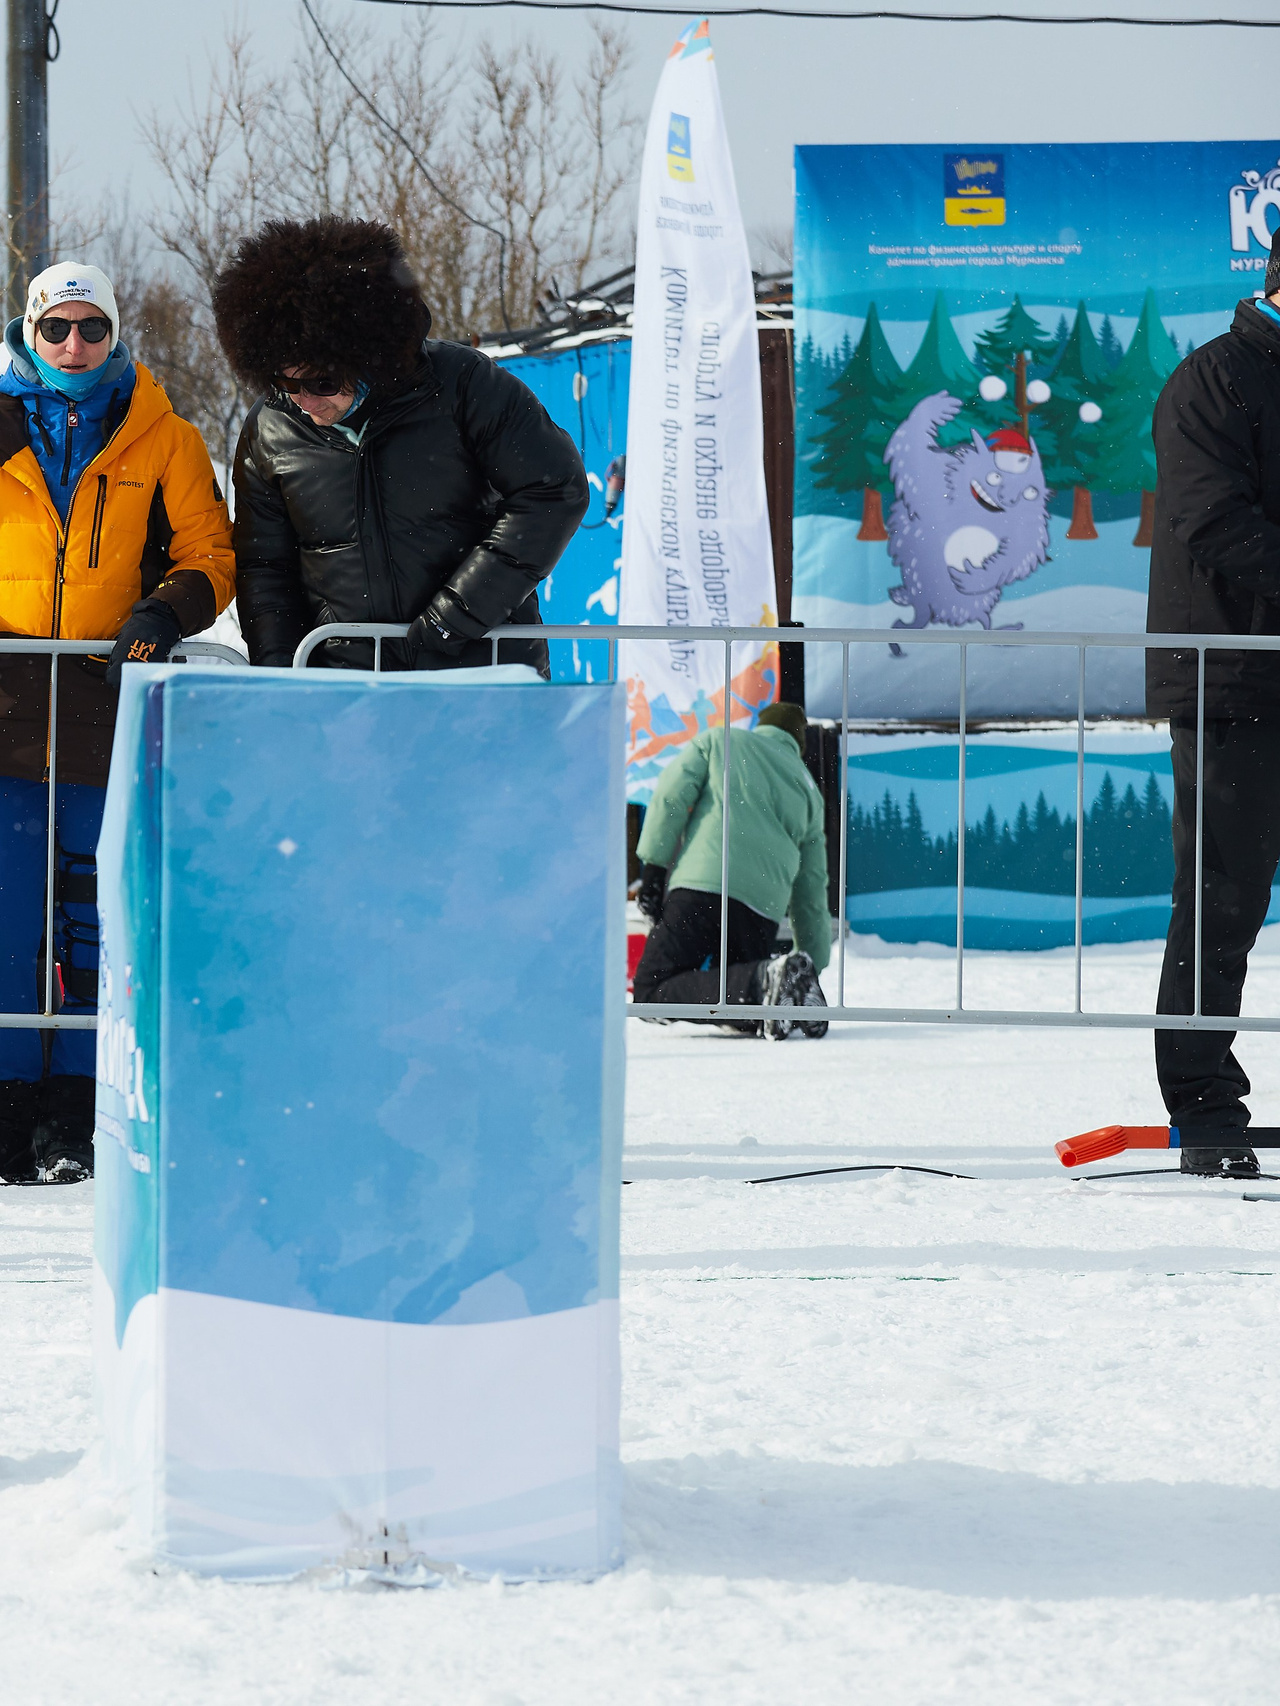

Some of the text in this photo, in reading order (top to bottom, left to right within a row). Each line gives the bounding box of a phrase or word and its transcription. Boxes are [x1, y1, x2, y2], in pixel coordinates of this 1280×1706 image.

[868, 244, 911, 255] Комитет
[928, 244, 989, 256] физической
[118, 481, 144, 489] PROTEST
